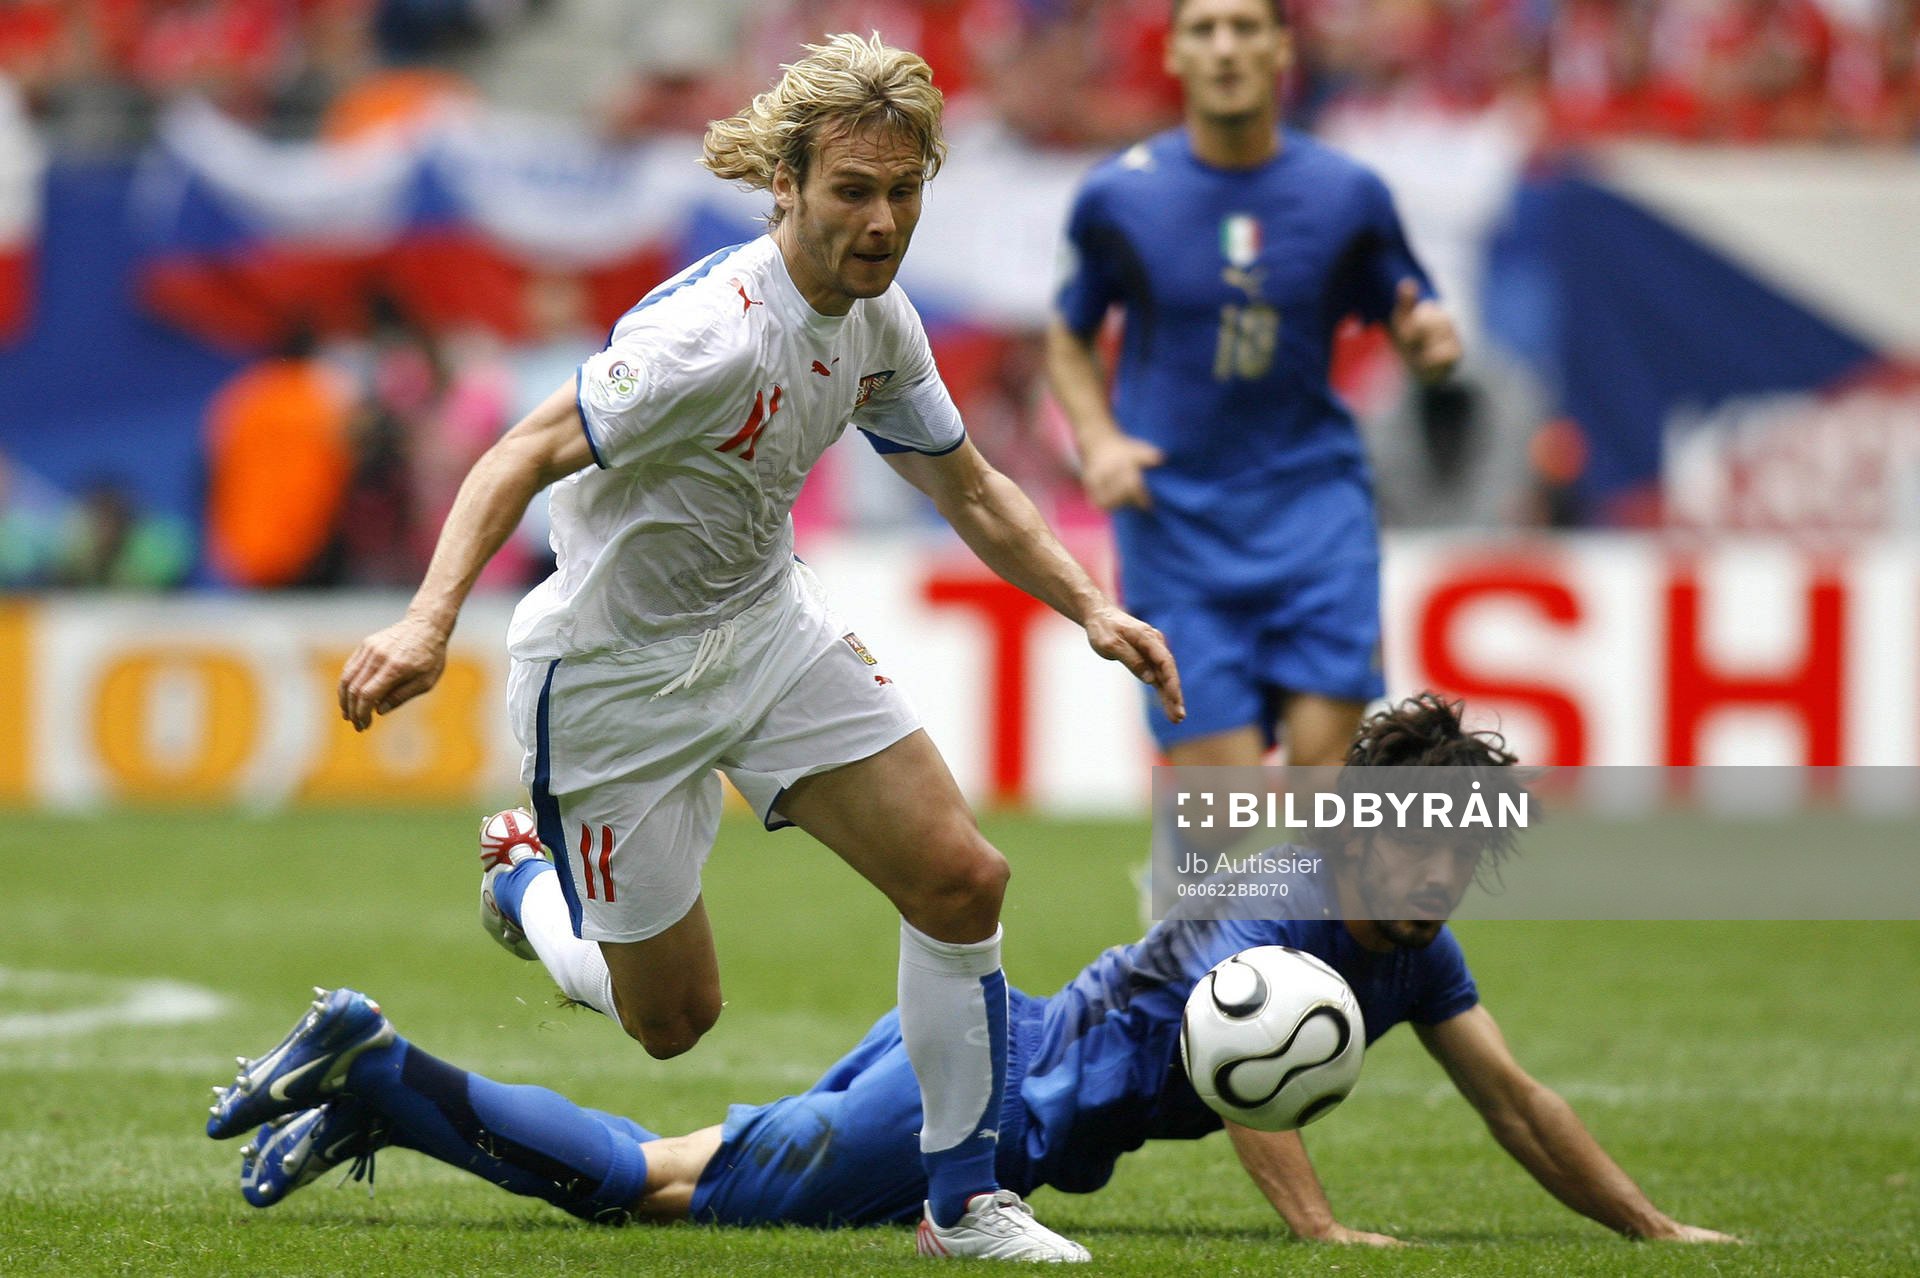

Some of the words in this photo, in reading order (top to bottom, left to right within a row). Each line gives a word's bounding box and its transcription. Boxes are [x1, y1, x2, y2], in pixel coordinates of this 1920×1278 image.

[1213, 305, 1279, 382] 10
[713, 383, 783, 461] 11
[925, 560, 1848, 806] TSH
[579, 822, 617, 903] 11
